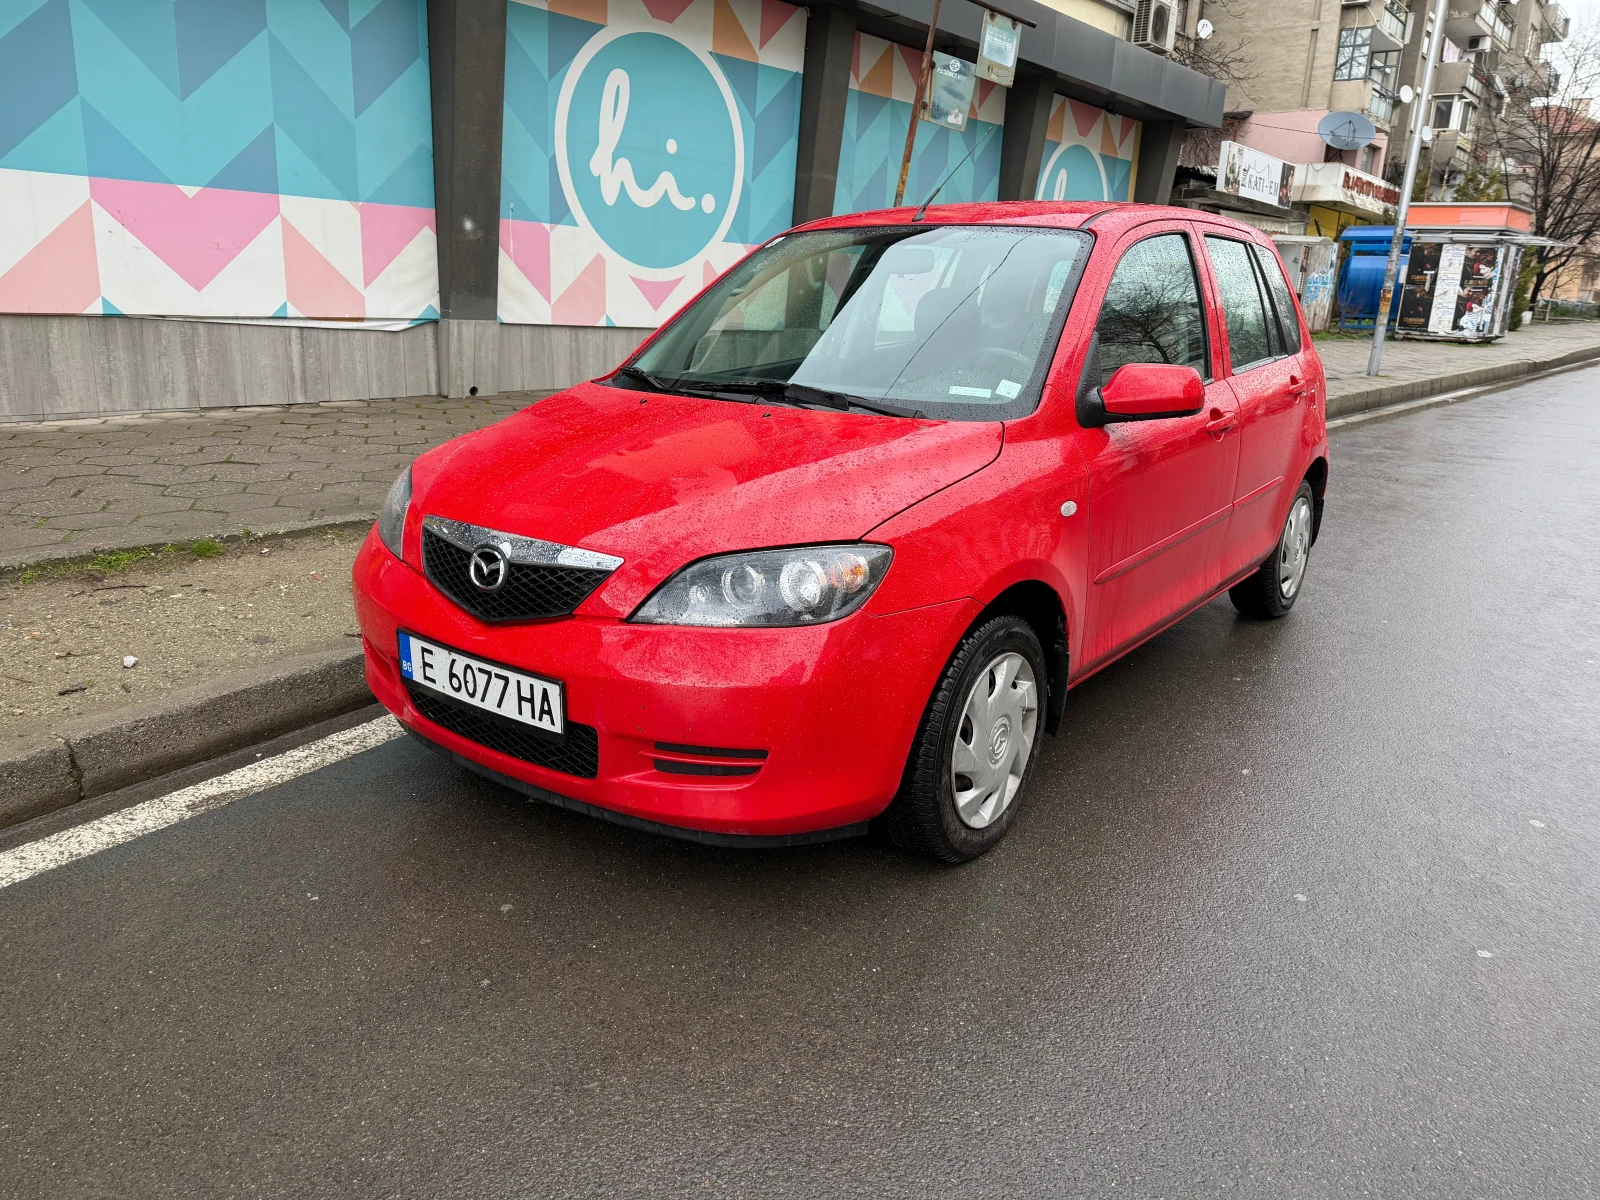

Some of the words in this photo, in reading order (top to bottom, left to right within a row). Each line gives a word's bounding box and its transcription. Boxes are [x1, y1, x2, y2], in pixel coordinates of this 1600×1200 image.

[589, 68, 716, 214] hi.
[402, 659, 412, 673] BG
[421, 646, 437, 684] E
[449, 658, 510, 709] 6077
[516, 679, 556, 727] HA
